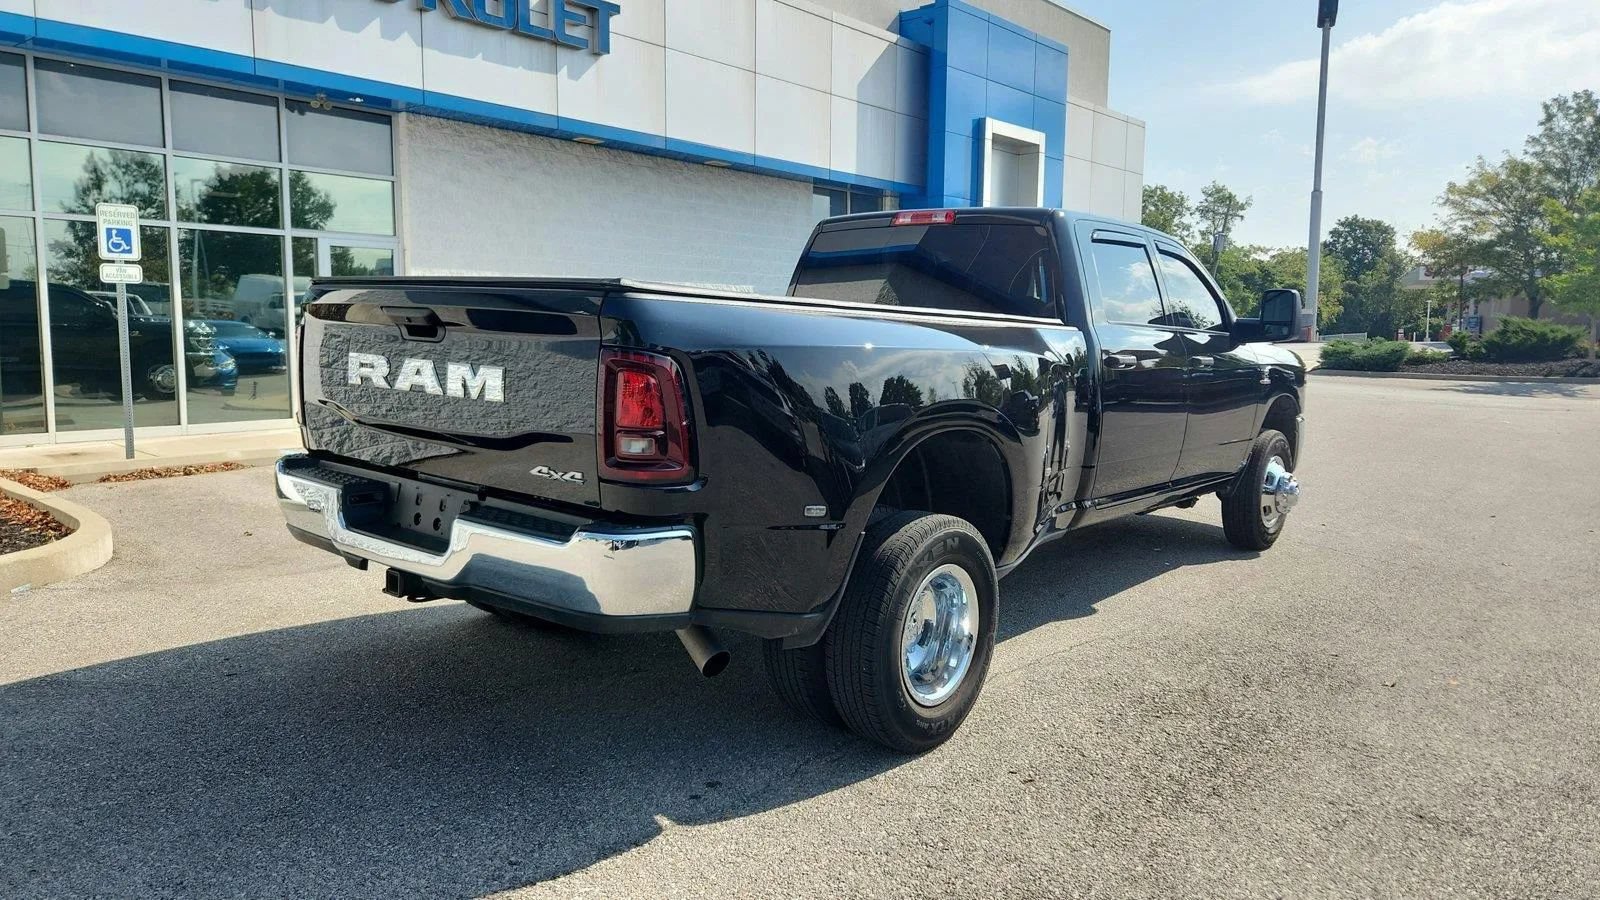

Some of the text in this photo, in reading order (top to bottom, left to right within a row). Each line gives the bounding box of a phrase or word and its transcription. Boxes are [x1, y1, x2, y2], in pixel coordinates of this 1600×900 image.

[100, 210, 135, 219] RESERVED
[103, 219, 133, 227] PARKING
[348, 352, 507, 403] RAM
